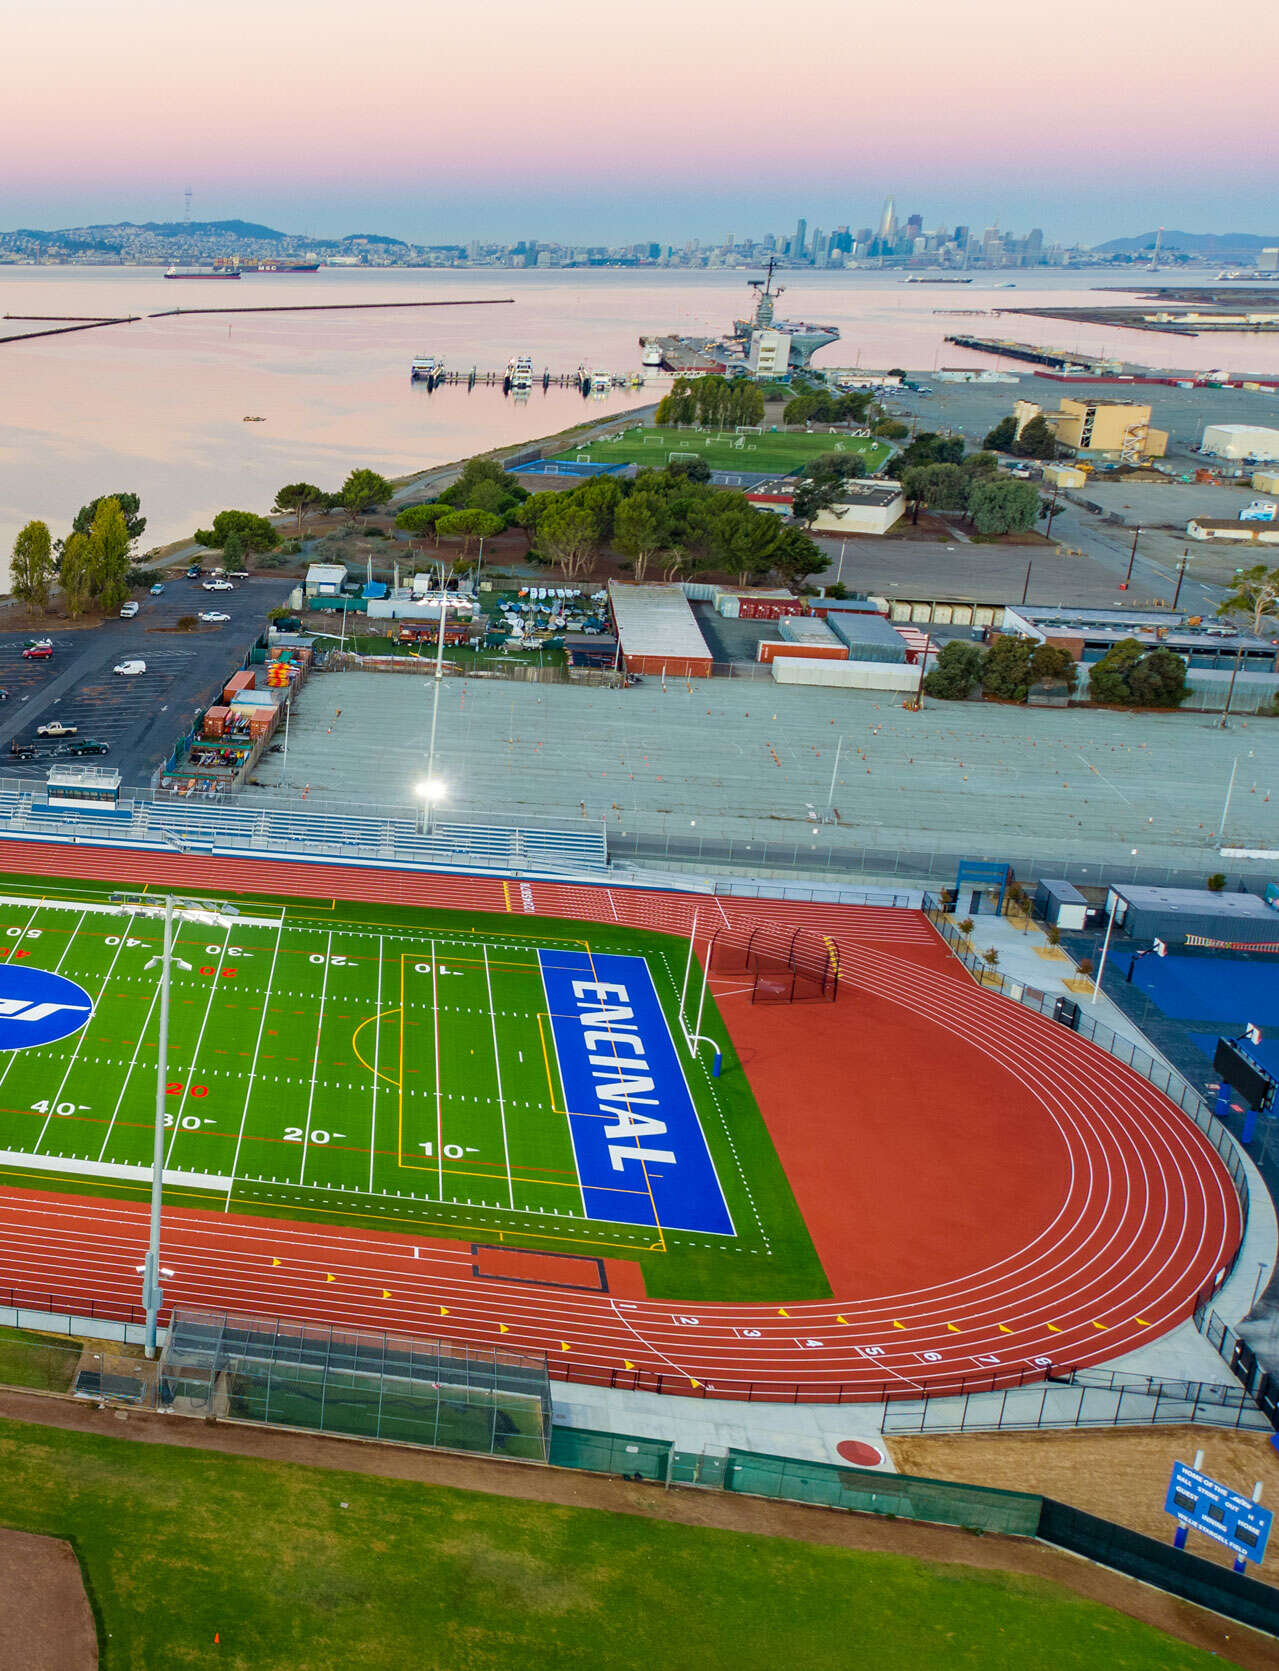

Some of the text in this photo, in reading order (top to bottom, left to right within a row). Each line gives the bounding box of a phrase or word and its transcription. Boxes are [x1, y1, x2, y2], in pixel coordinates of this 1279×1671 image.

[6, 926, 43, 939] 50
[104, 935, 142, 948] 40
[205, 945, 243, 957] 30
[309, 953, 348, 967] 20
[200, 966, 238, 978] 20
[414, 962, 453, 976] 10
[571, 979, 678, 1173] ENCINAL
[165, 1082, 209, 1098] 20
[30, 1099, 77, 1117] 40
[283, 1126, 330, 1145] 20
[418, 1141, 465, 1160] 10
[679, 1317, 700, 1325] 2
[742, 1329, 762, 1337] 3
[805, 1339, 824, 1347] 4
[865, 1346, 886, 1356] 5
[923, 1352, 943, 1361] 6
[978, 1354, 1001, 1364] 7
[1176, 1474, 1192, 1487] BALL
[1181, 1467, 1204, 1483] HOME
[1214, 1484, 1228, 1497] THE
[1175, 1485, 1199, 1501] GUEST
[1197, 1486, 1220, 1502] STRIKE
[1224, 1501, 1240, 1512] OUT
[1238, 1519, 1261, 1536] HOME
